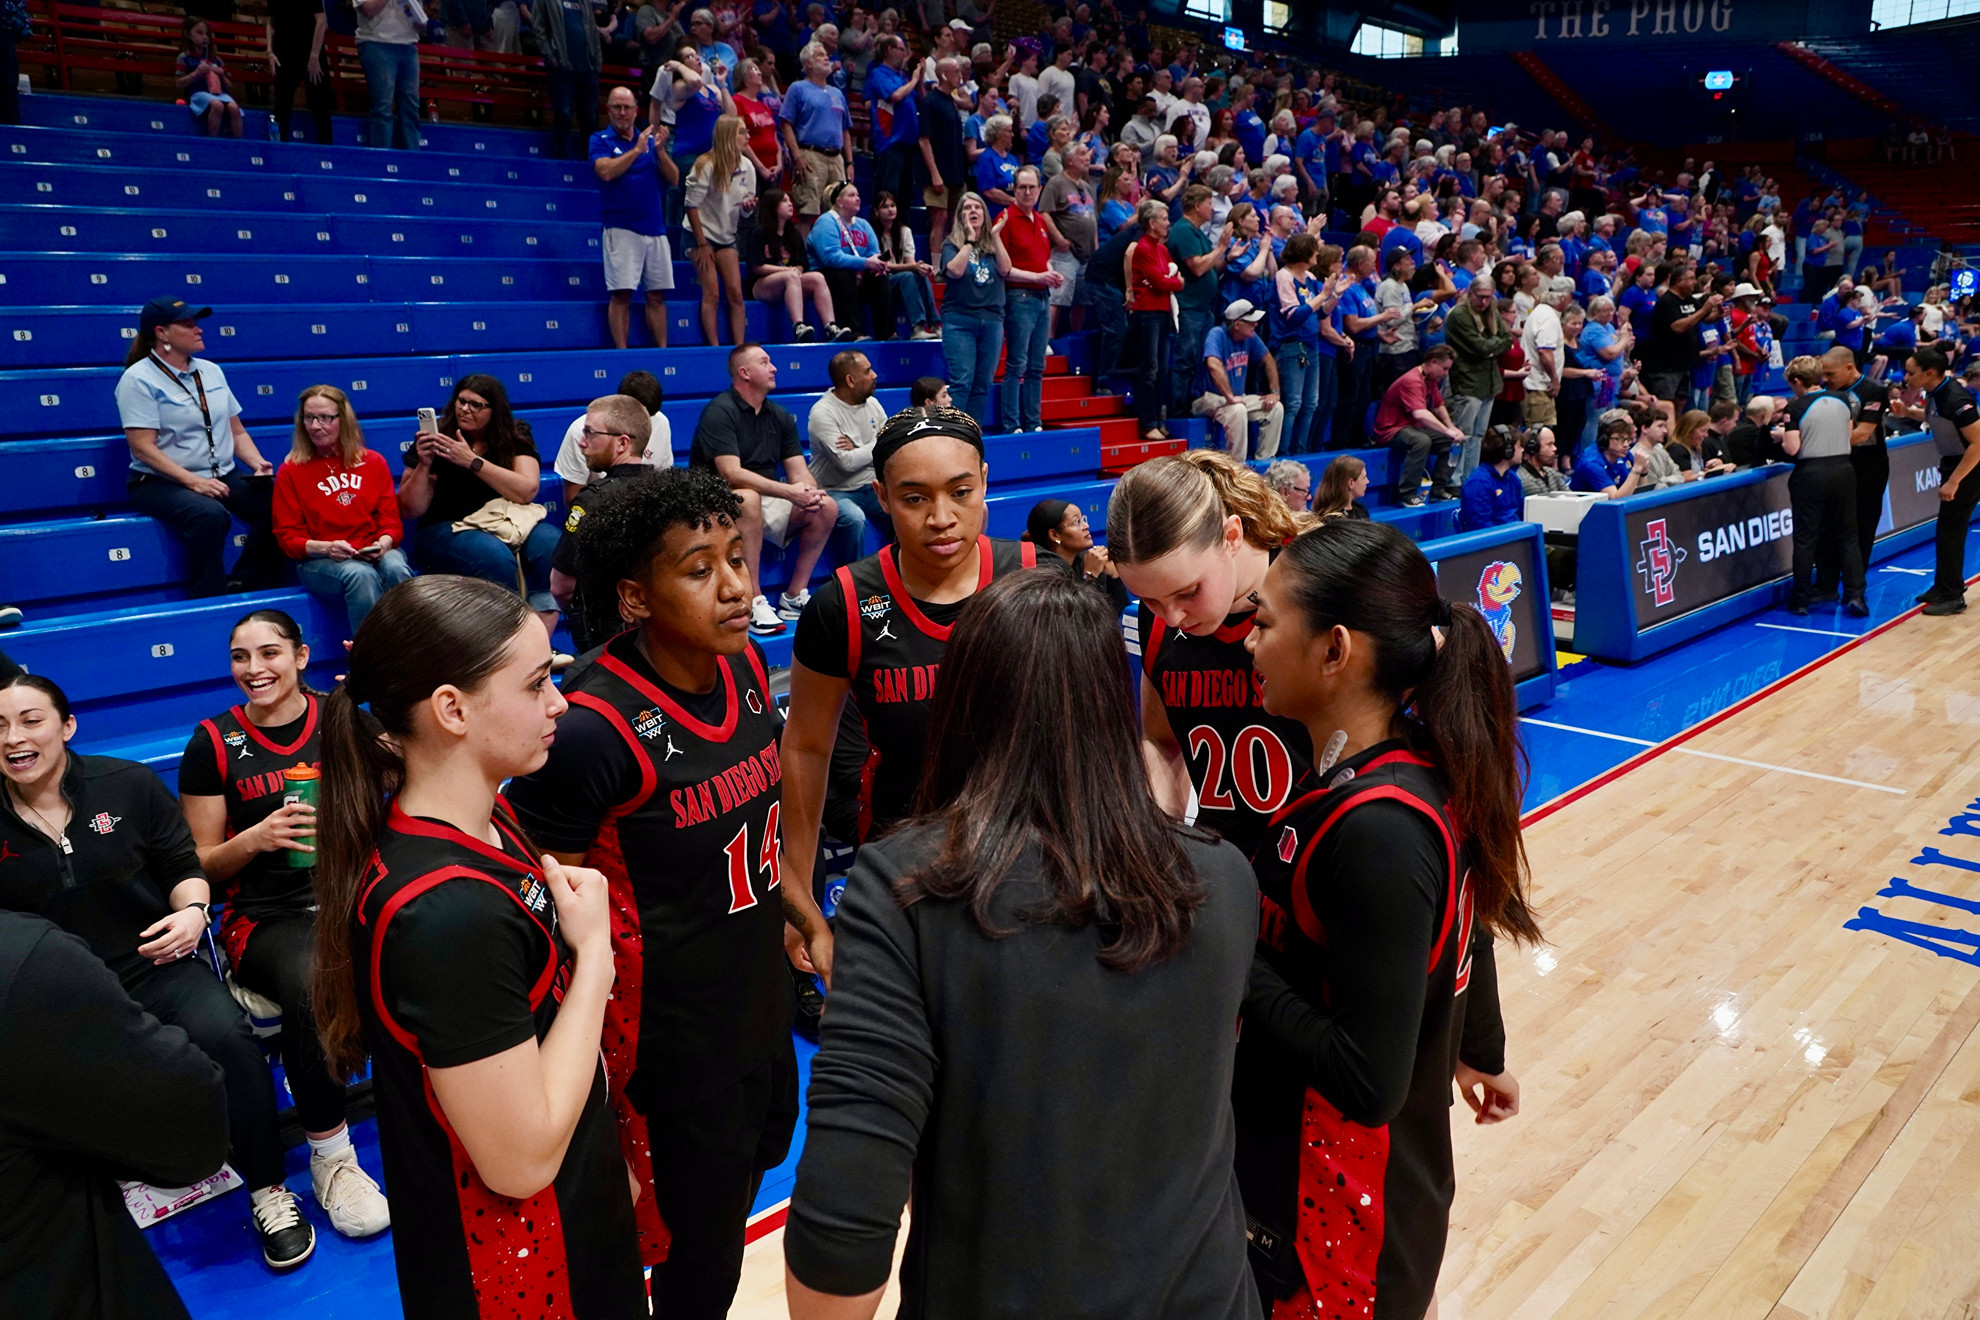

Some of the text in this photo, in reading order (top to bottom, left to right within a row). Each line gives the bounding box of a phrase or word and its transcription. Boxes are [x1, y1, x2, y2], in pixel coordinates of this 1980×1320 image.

[1530, 0, 1733, 39] THE PHOG
[128, 186, 136, 195] 10
[211, 189, 217, 198] 11
[156, 229, 164, 238] 10
[242, 231, 248, 239] 11
[320, 232, 328, 240] 12
[190, 275, 198, 284] 10
[279, 275, 286, 283] 11
[358, 275, 367, 283] 12
[224, 327, 232, 336] 10
[316, 325, 322, 333] 11
[399, 324, 407, 332] 12
[357, 381, 363, 390] 11
[442, 378, 450, 386] 12
[262, 386, 270, 394] 10
[317, 473, 362, 496] SDSU
[547, 503, 555, 511] 12
[1698, 521, 1745, 563] SAN
[861, 601, 891, 613] WBIT
[159, 645, 166, 656] 8
[873, 668, 908, 703] SAN
[1162, 671, 1188, 708] SAN
[1190, 669, 1247, 708] DIEGO
[635, 714, 663, 733] WBIT
[1188, 725, 1293, 814] 20
[236, 774, 267, 801] SAN
[670, 781, 718, 829] SAN
[711, 756, 768, 814] DIEGO
[723, 800, 780, 914] 14
[524, 880, 541, 908] WBIT
[1261, 1235, 1273, 1249] M
